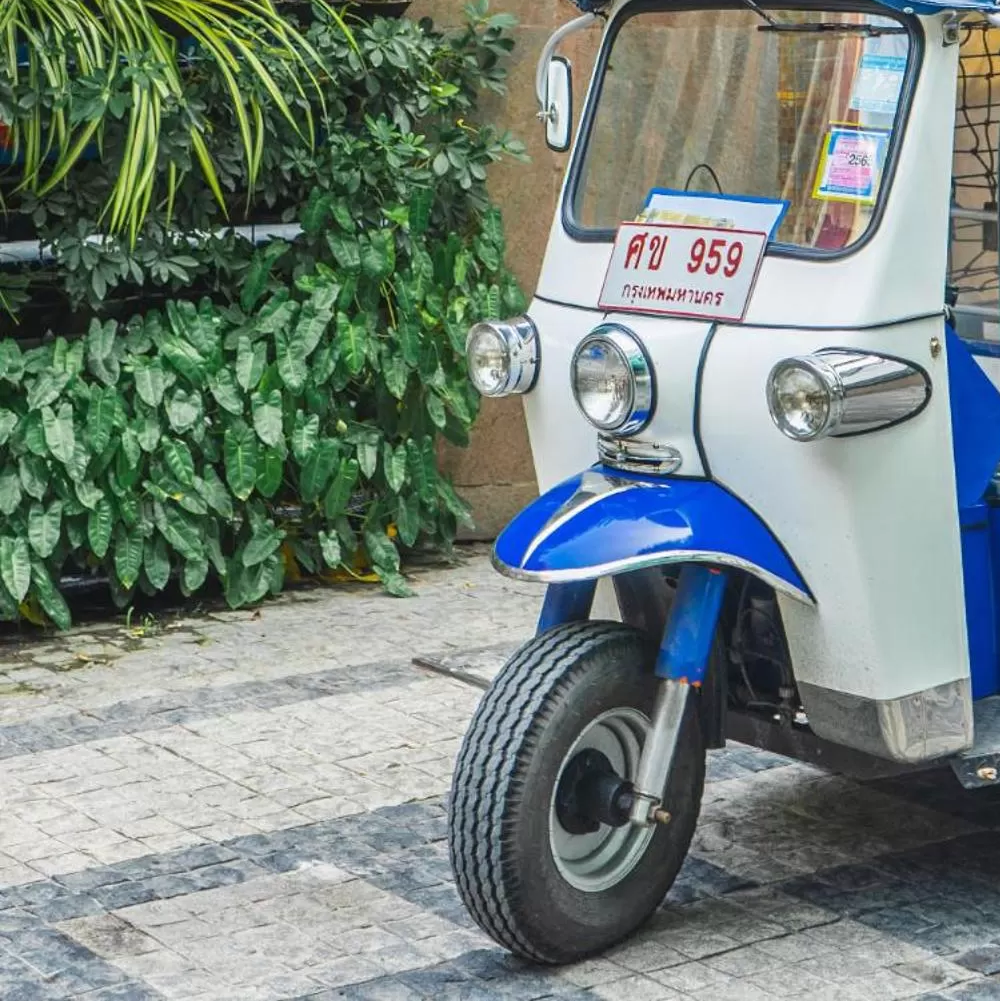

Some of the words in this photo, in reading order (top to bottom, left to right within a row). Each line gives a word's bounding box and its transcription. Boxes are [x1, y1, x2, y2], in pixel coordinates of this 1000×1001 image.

[623, 231, 668, 271] ศข
[687, 237, 744, 278] 959
[621, 282, 725, 307] กรุงเทพมหานคร
